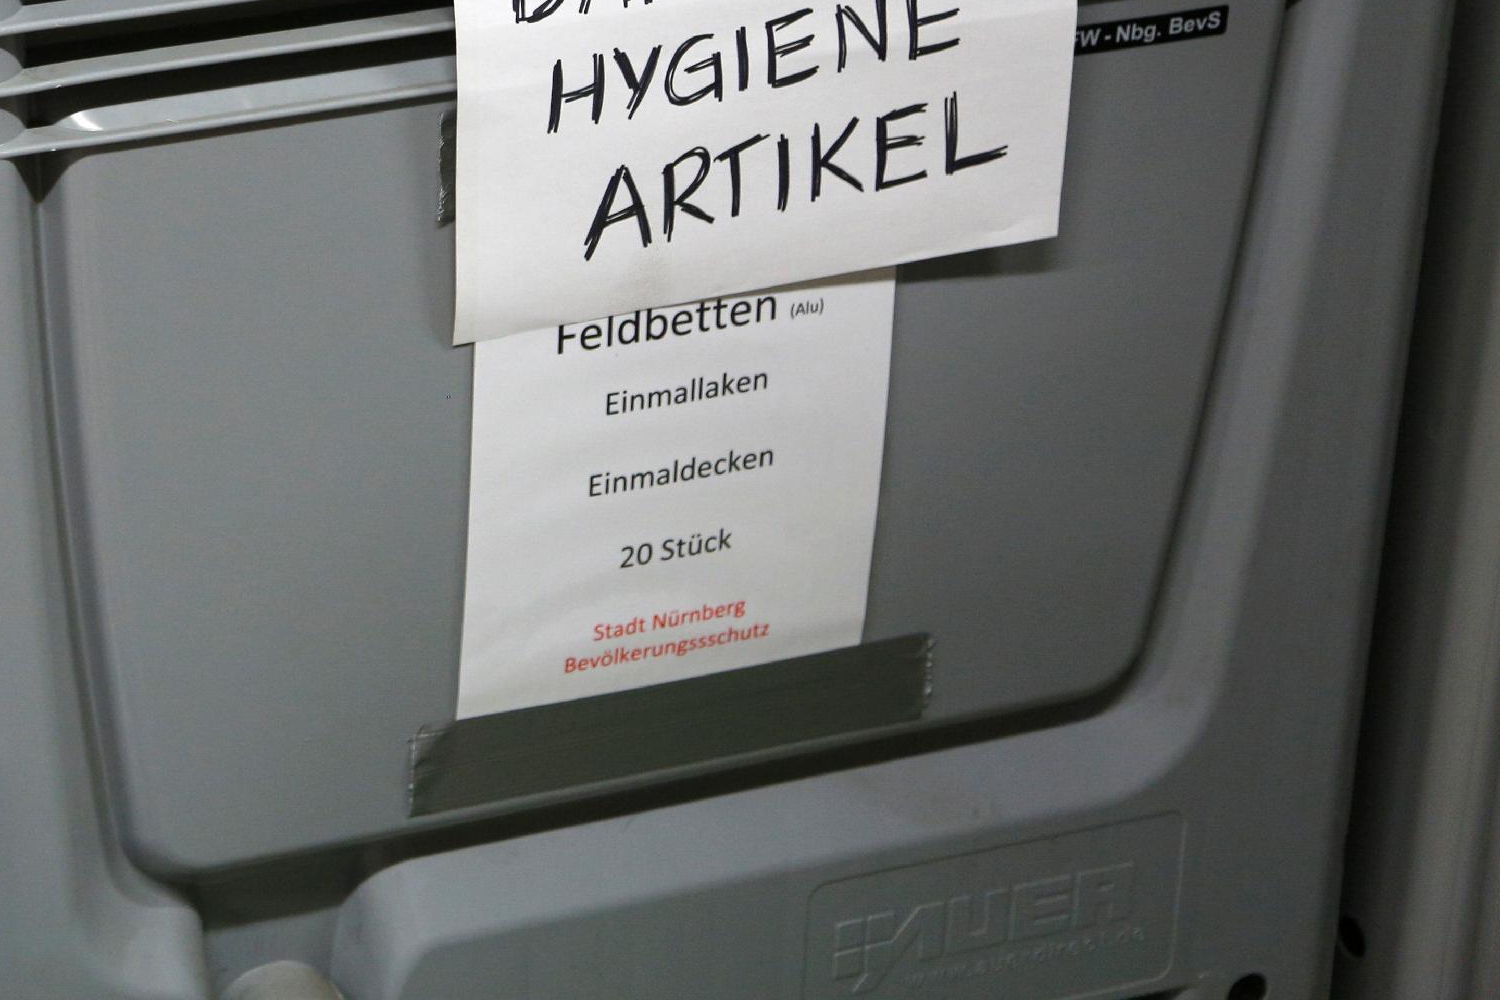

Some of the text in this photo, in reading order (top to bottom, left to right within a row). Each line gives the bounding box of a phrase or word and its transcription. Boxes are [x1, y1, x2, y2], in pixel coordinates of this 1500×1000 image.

[1115, 22, 1162, 43] Nbg.
[1168, 10, 1222, 36] BevS
[583, 91, 1009, 261] ARTIKEL
[557, 295, 825, 355] Feldbetten (Alu)
[605, 372, 769, 416] Einmallaken
[588, 447, 775, 498] Einmaldecken
[619, 527, 733, 569] 20 Stück
[593, 599, 747, 643] Stadt Nürnberg
